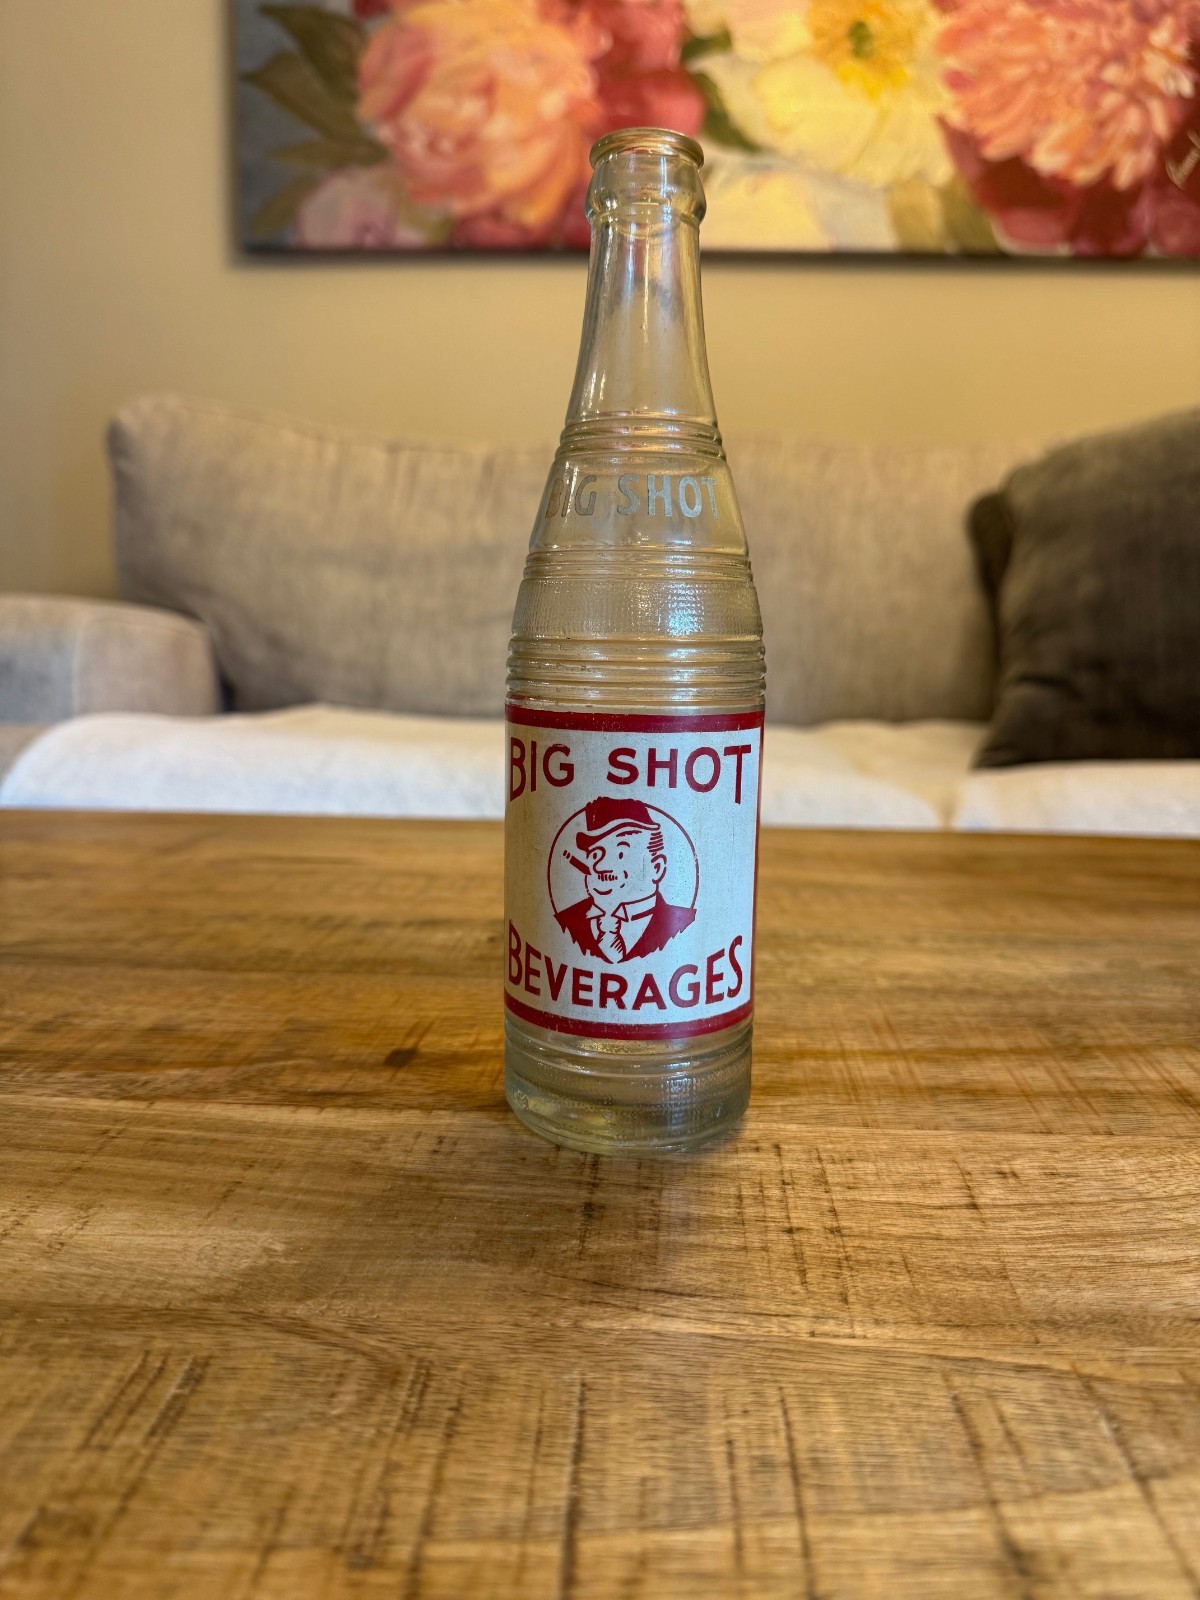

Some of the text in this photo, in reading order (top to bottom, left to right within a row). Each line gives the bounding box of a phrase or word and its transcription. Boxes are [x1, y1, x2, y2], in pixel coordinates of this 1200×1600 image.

[545, 473, 718, 519] BIG SHOT
[510, 736, 752, 804] BIG SHOT
[508, 918, 743, 1011] BEVERAGES
